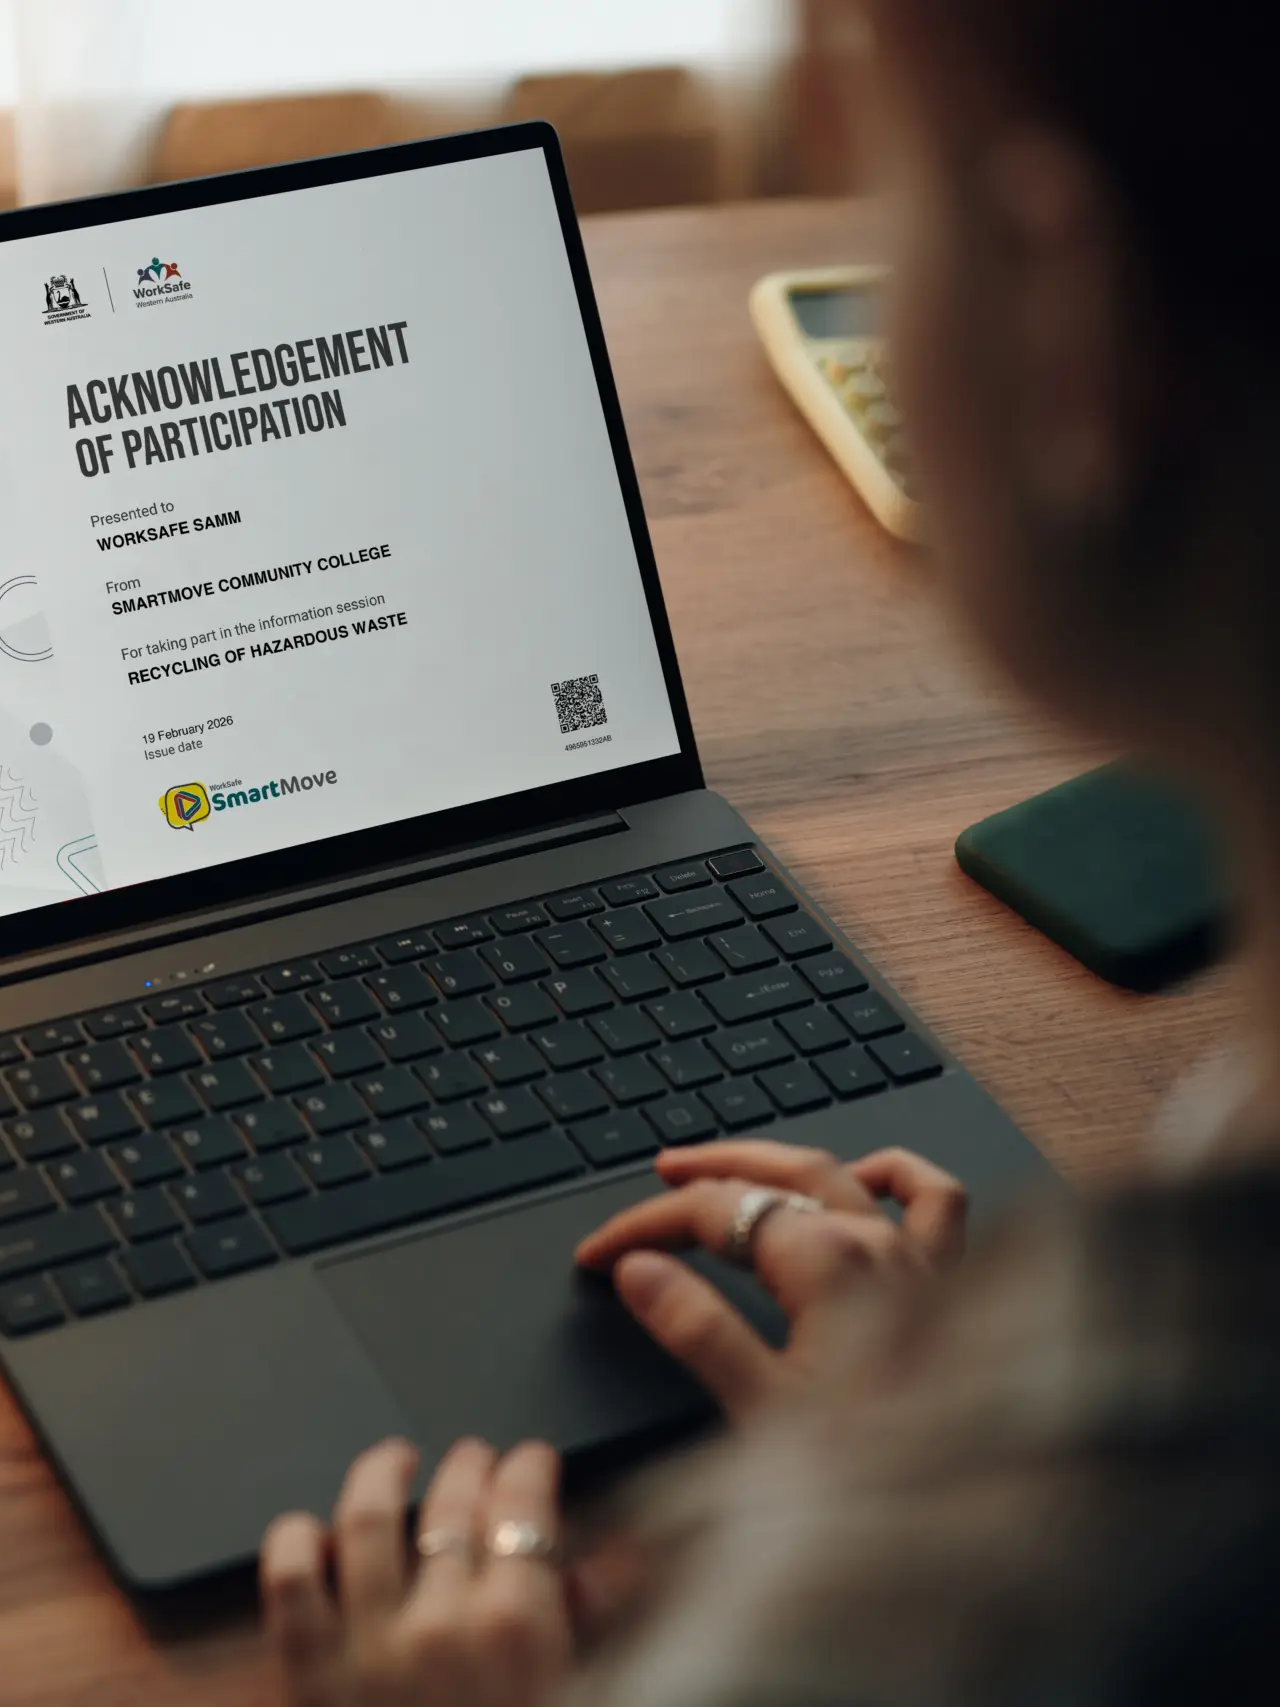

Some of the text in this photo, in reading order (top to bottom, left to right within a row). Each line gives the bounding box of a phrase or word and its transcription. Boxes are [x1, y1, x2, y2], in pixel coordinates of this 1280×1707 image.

[133, 281, 191, 299] WorkSafe
[135, 293, 193, 308] Western Australia
[44, 313, 91, 326] WESTERN AUSTRALIA
[66, 321, 409, 429] ACKNOWLEDGEMENT
[76, 389, 347, 478] OF PARTICIPATION
[90, 502, 174, 528] Presented to
[96, 510, 241, 551] WORKSAFE SAMM
[105, 578, 141, 594] From
[112, 544, 392, 615] SMARTMOVE COMMUNITY COLLEGE
[121, 595, 386, 661] For taking part in the information session
[128, 612, 408, 685] RECYCLING OF HAZARDOUS WASTE
[142, 715, 234, 744] 19 February 2026
[144, 740, 203, 760] Issue date
[209, 778, 242, 791] WorkSafe
[211, 770, 337, 811] SmartMove
[669, 871, 697, 882] Delete
[635, 888, 650, 896] F12
[749, 888, 776, 899] Home
[502, 961, 515, 972] 0
[444, 976, 456, 987] 9
[554, 981, 567, 993] P
[380, 1027, 397, 1040] U
[322, 1041, 336, 1054] Y
[540, 1036, 557, 1049] L
[484, 1050, 502, 1063] K
